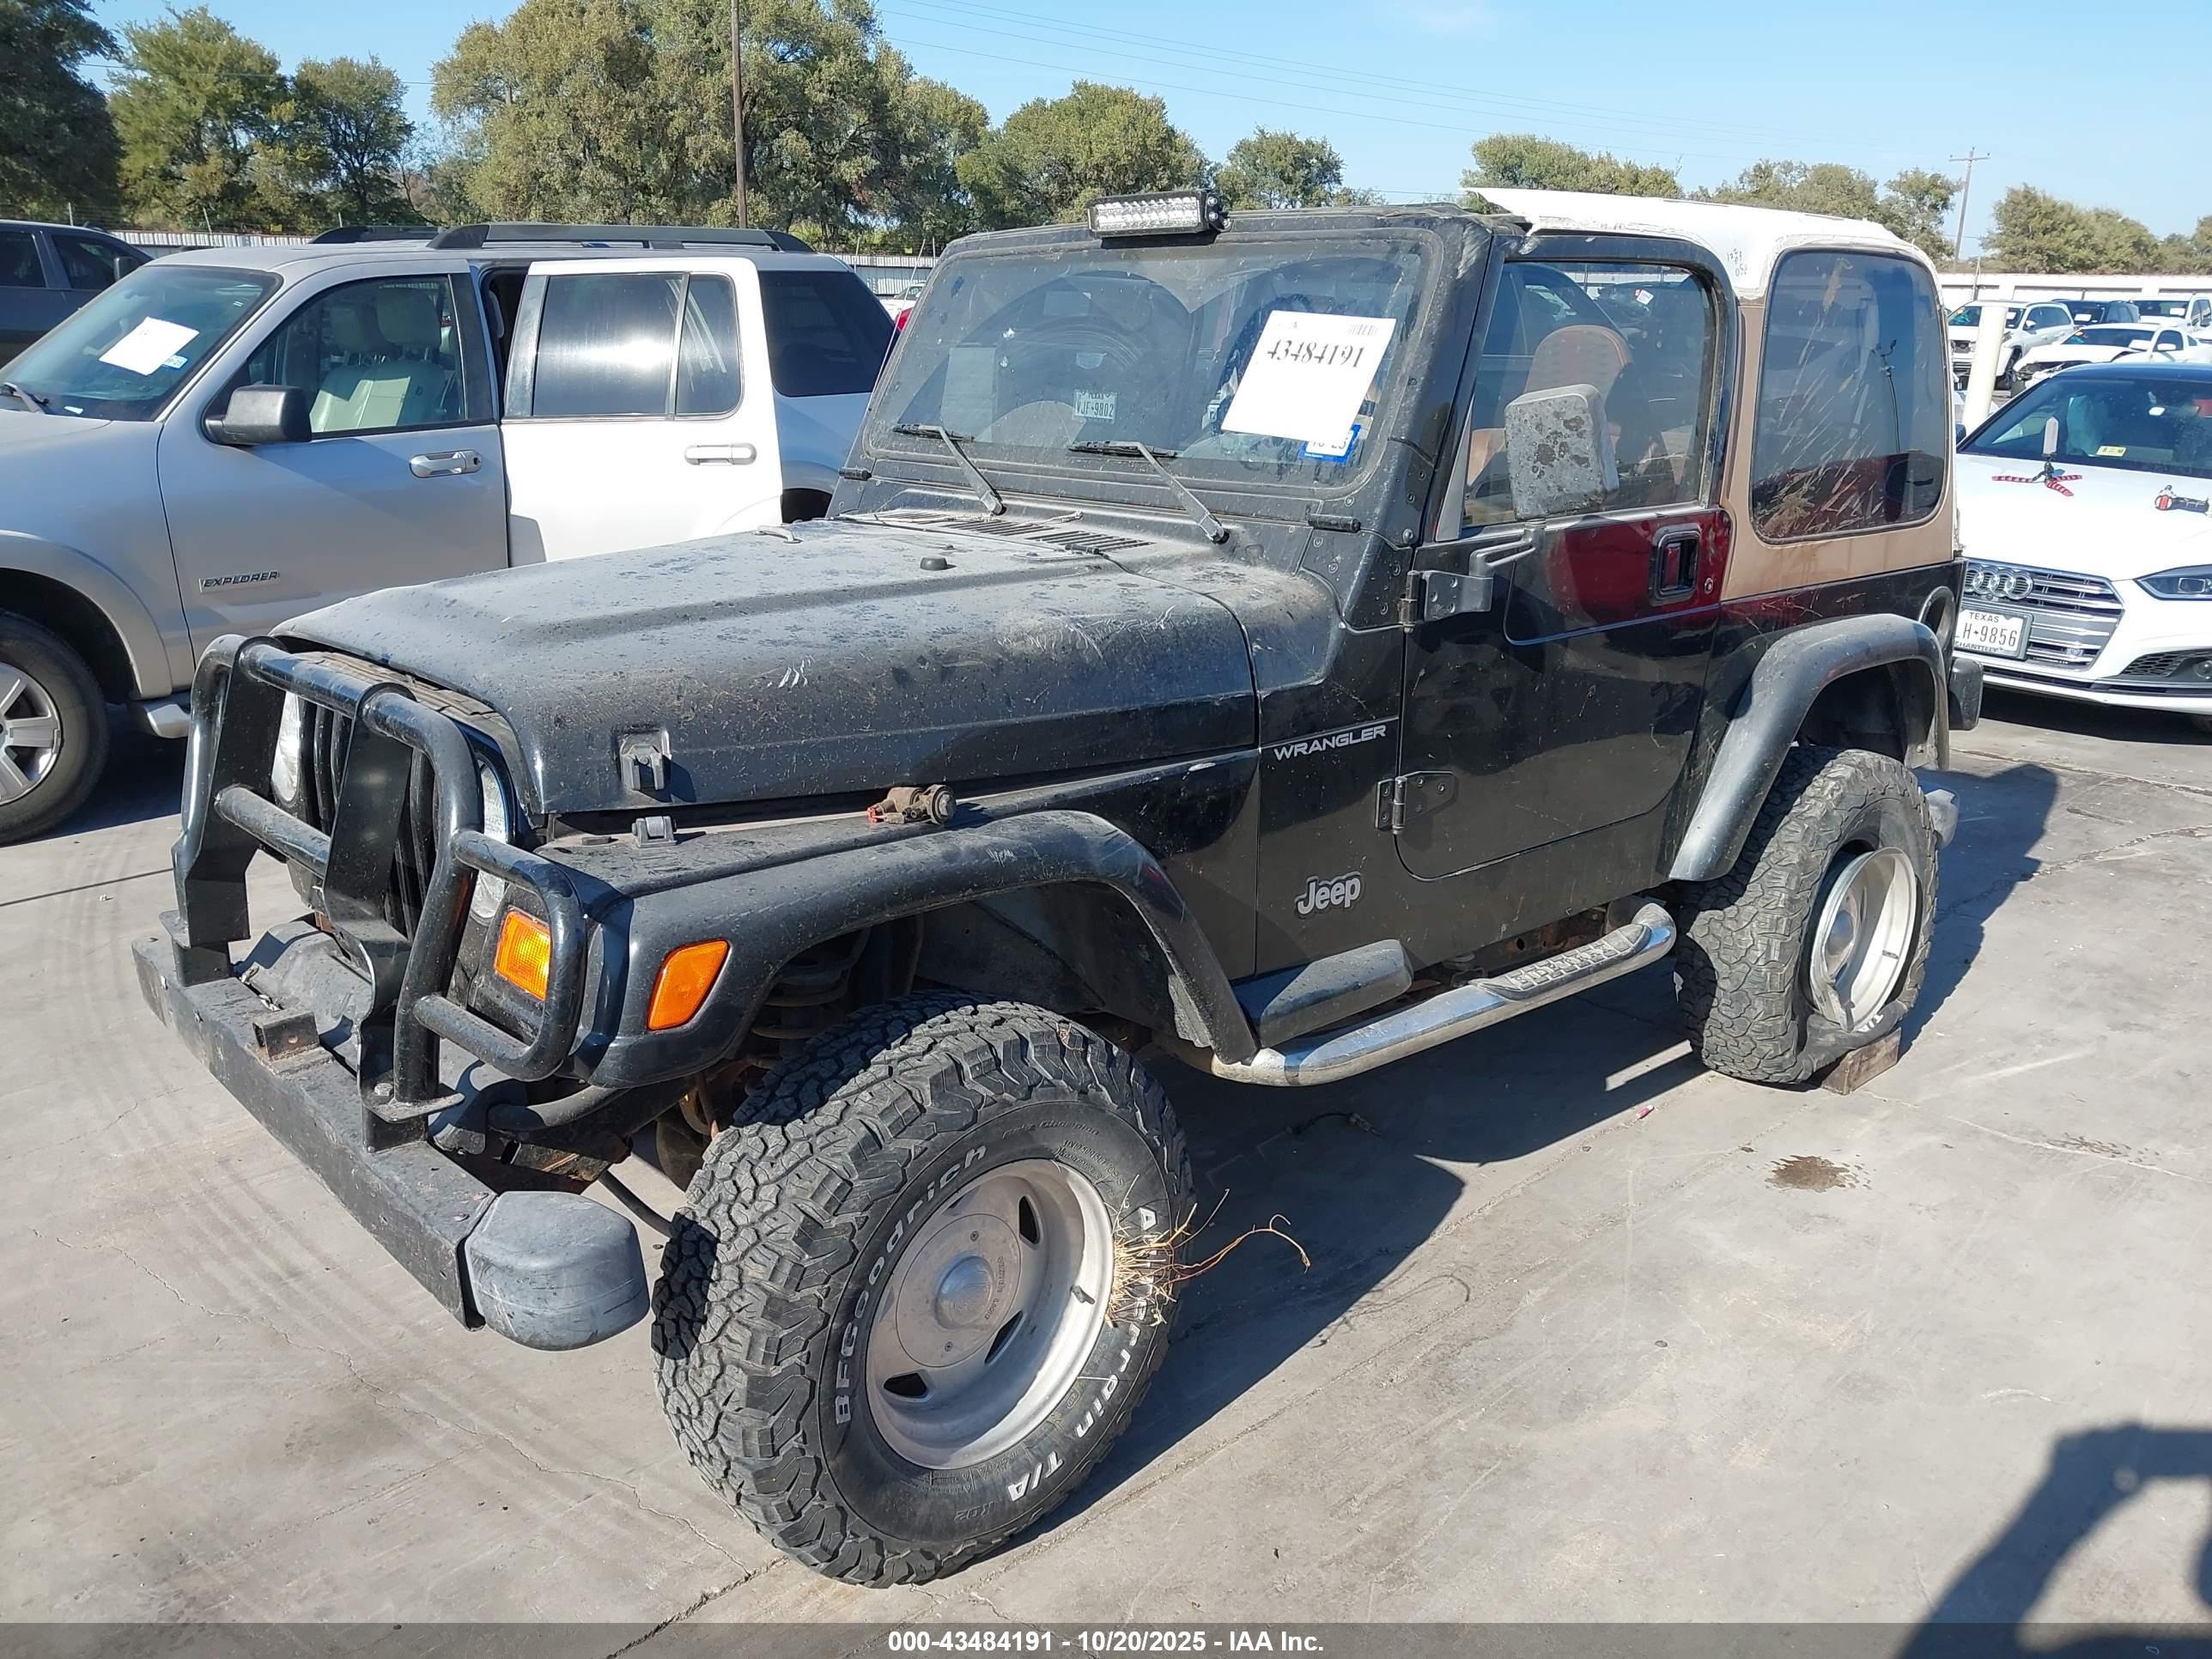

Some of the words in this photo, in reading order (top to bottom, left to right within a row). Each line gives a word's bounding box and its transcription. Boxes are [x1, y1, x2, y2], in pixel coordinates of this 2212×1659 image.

[1267, 338, 1364, 368] 43484191
[204, 570, 280, 587] EXPLORER
[1969, 611, 2000, 623] TEXAS
[1273, 725, 1387, 762] WRANGLER
[1296, 873, 1362, 916] Jeep
[1007, 1450, 1066, 1502] T/A
